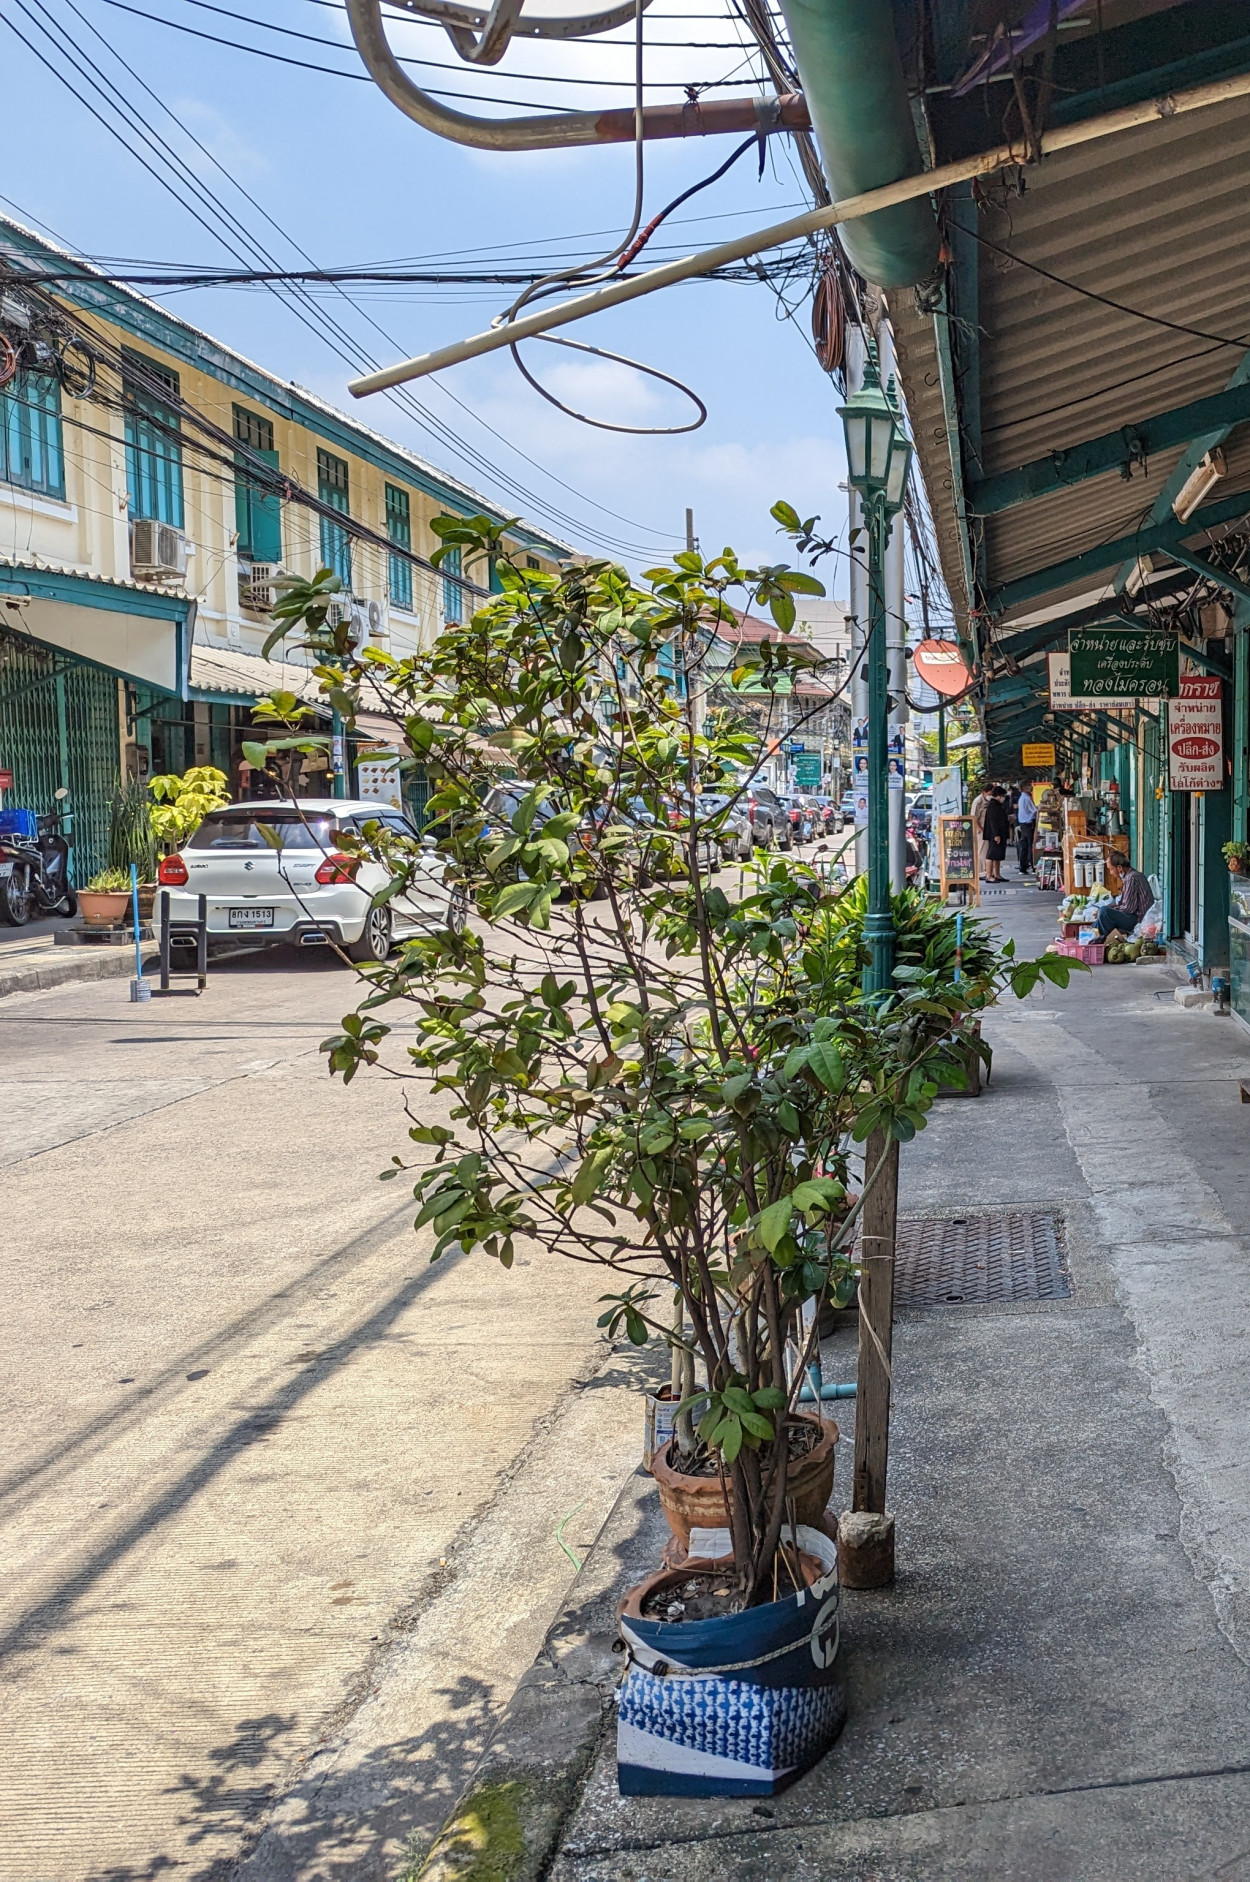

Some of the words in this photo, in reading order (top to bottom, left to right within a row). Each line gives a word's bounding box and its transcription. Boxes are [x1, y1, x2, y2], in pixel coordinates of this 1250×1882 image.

[1097, 653, 1154, 670] เครื่องประดับ
[1174, 702, 1216, 713] จำหน่าย
[1170, 714, 1221, 735] เครื่องหมาย
[1177, 741, 1215, 756] ปลีก-ส่ง
[1178, 762, 1216, 773] รับผลิต
[1171, 775, 1223, 789] โลโก้ต่างๆ
[252, 910, 271, 918] 1513
